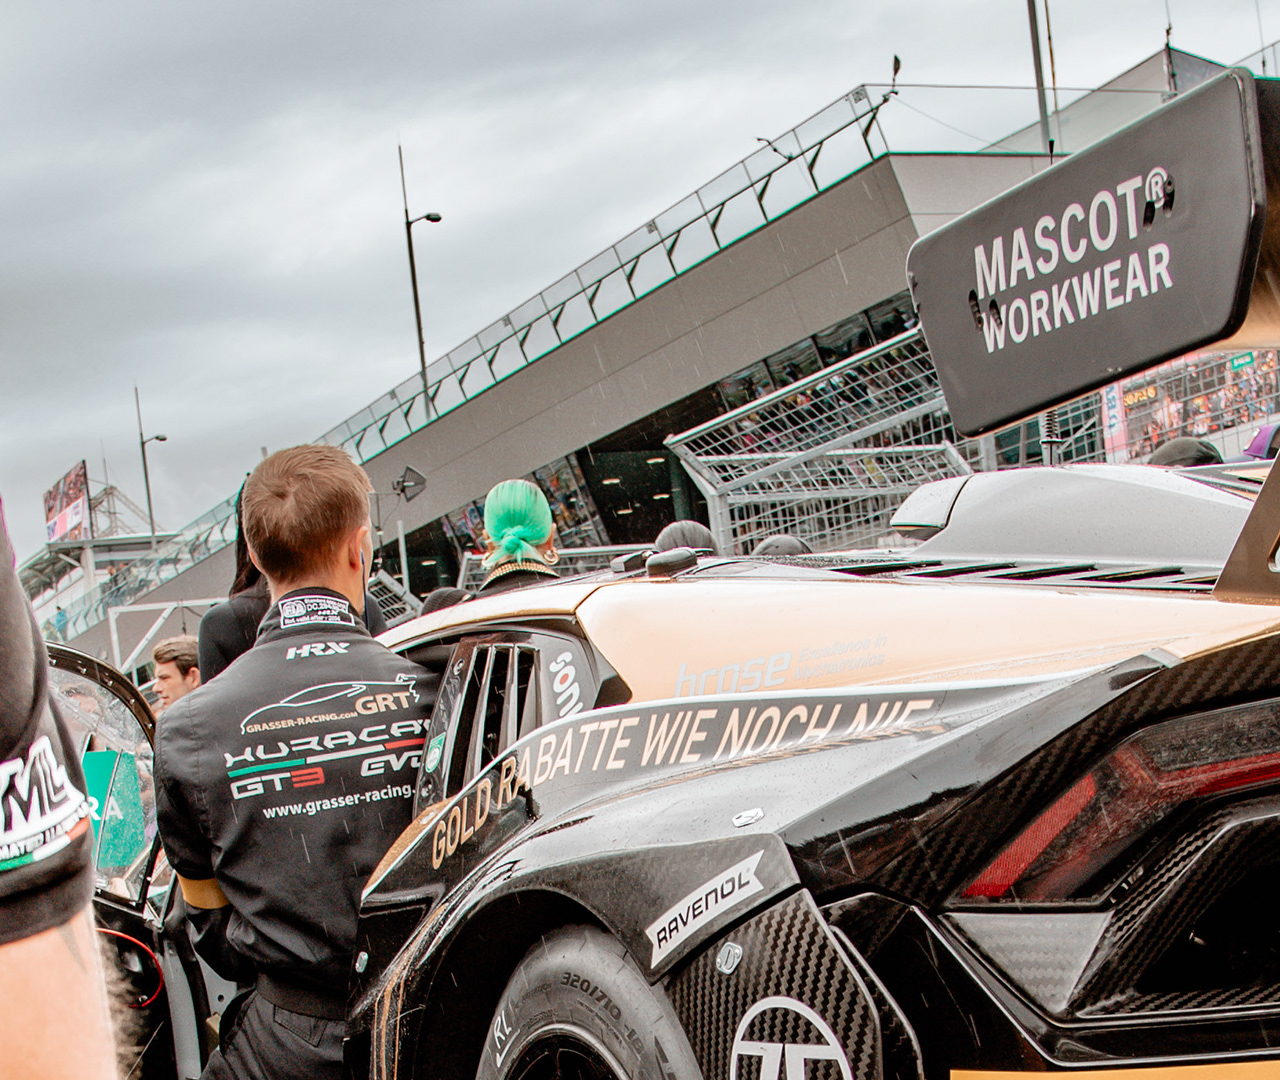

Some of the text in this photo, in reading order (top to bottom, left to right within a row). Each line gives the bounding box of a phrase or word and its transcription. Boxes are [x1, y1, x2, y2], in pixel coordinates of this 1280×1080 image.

[981, 242, 1174, 354] WORKWEAR
[286, 642, 350, 660] HRX
[793, 652, 885, 681] Mechatronics
[675, 651, 792, 698] brose
[355, 691, 412, 716] GRT
[230, 767, 325, 800] GT3
[263, 784, 417, 819] www.grasser-racing.
[432, 777, 493, 870] GOLD
[496, 717, 640, 811] RABATTE
[640, 708, 719, 768] WIE
[712, 703, 843, 761] NOCH
[656, 871, 751, 950] RAVENOL
[560, 971, 622, 1021] 320/710
